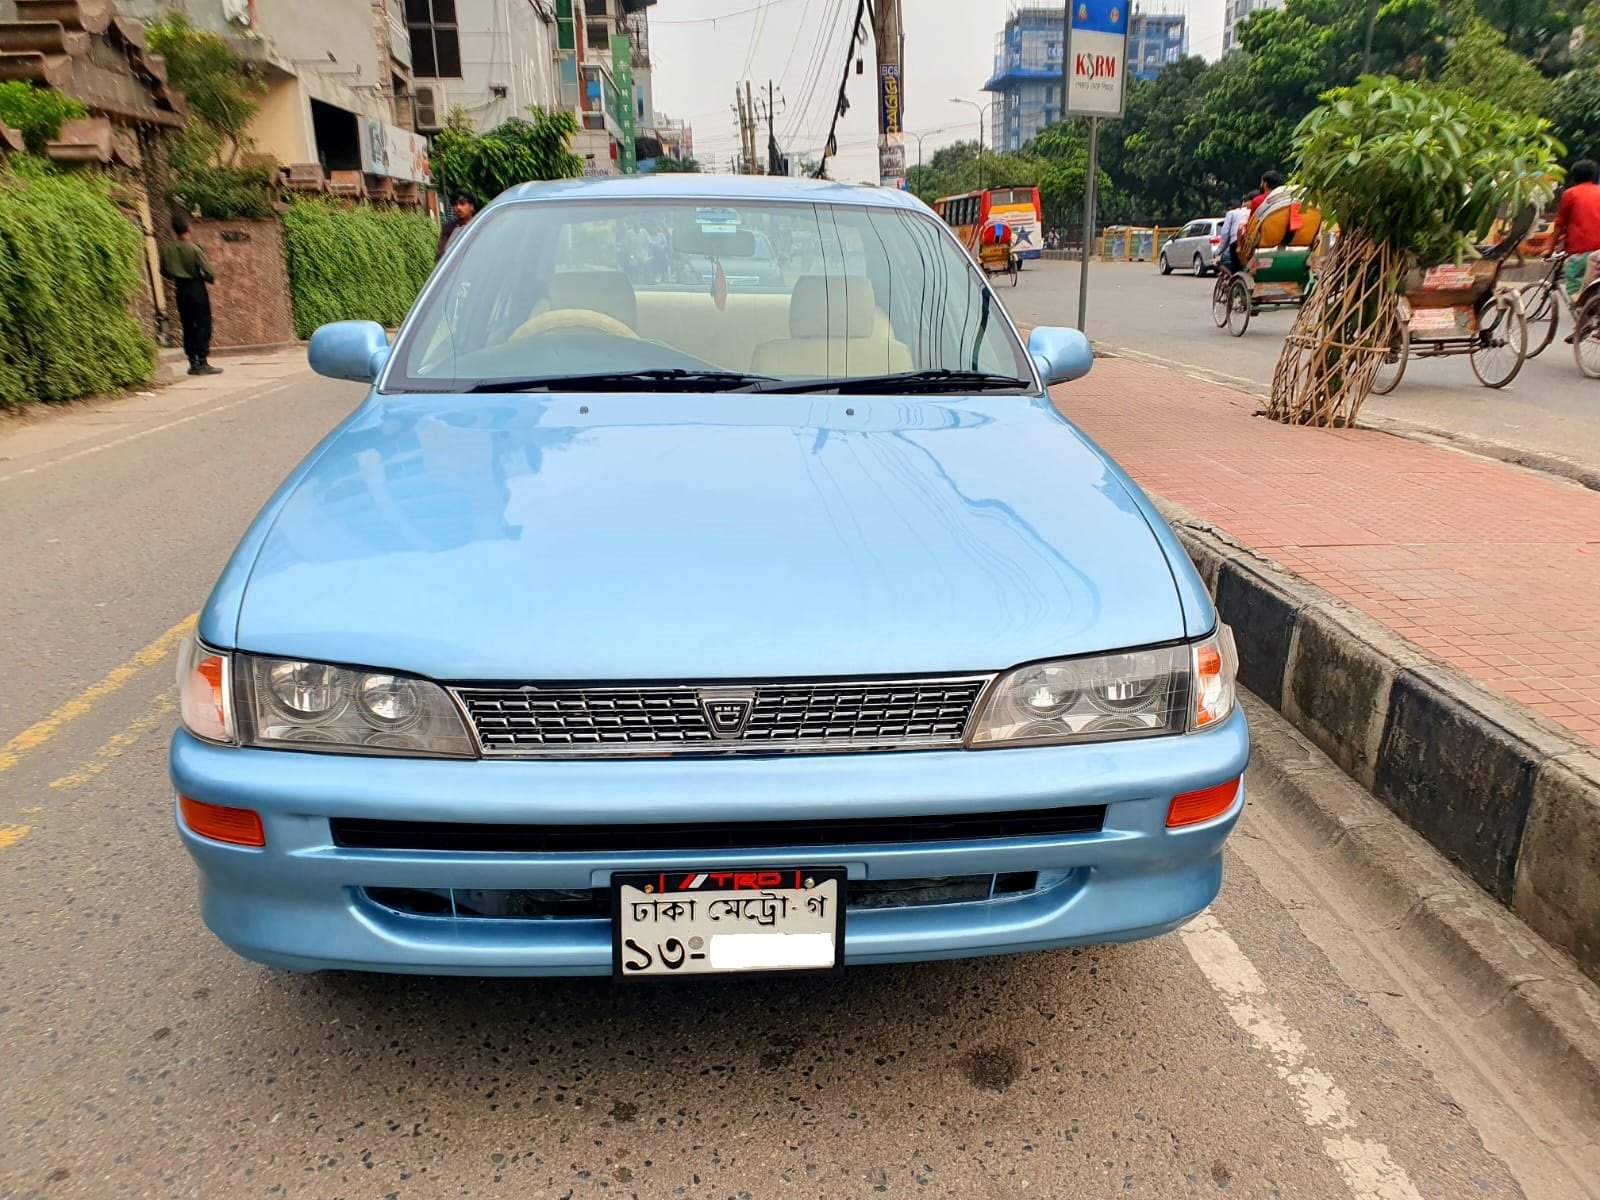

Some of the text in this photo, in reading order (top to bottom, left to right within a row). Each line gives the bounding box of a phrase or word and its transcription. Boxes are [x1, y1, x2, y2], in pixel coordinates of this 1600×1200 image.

[1076, 52, 1116, 79] KSRM
[709, 872, 781, 890] TRD
[631, 899, 696, 922] ঢাকা
